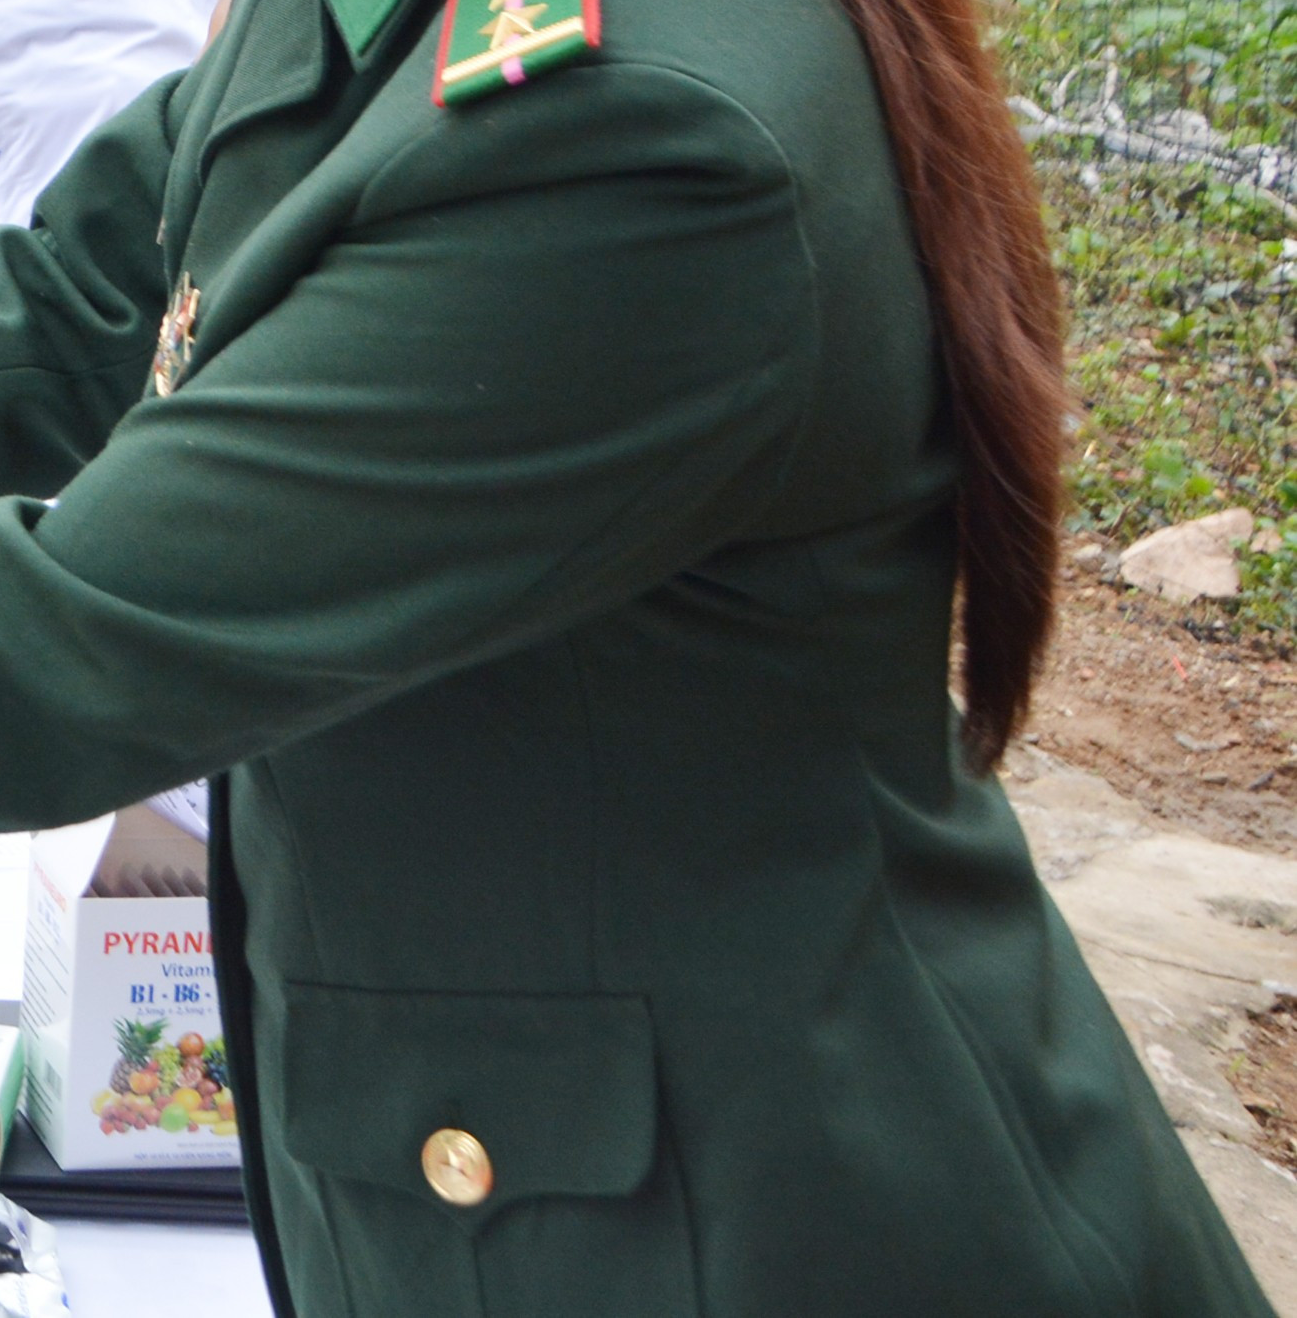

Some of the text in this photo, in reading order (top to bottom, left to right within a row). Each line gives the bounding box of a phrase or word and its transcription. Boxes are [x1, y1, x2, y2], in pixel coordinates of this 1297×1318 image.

[103, 931, 213, 955] PYRAN
[161, 963, 213, 979] Vitam
[130, 983, 200, 1004] B1 B6
